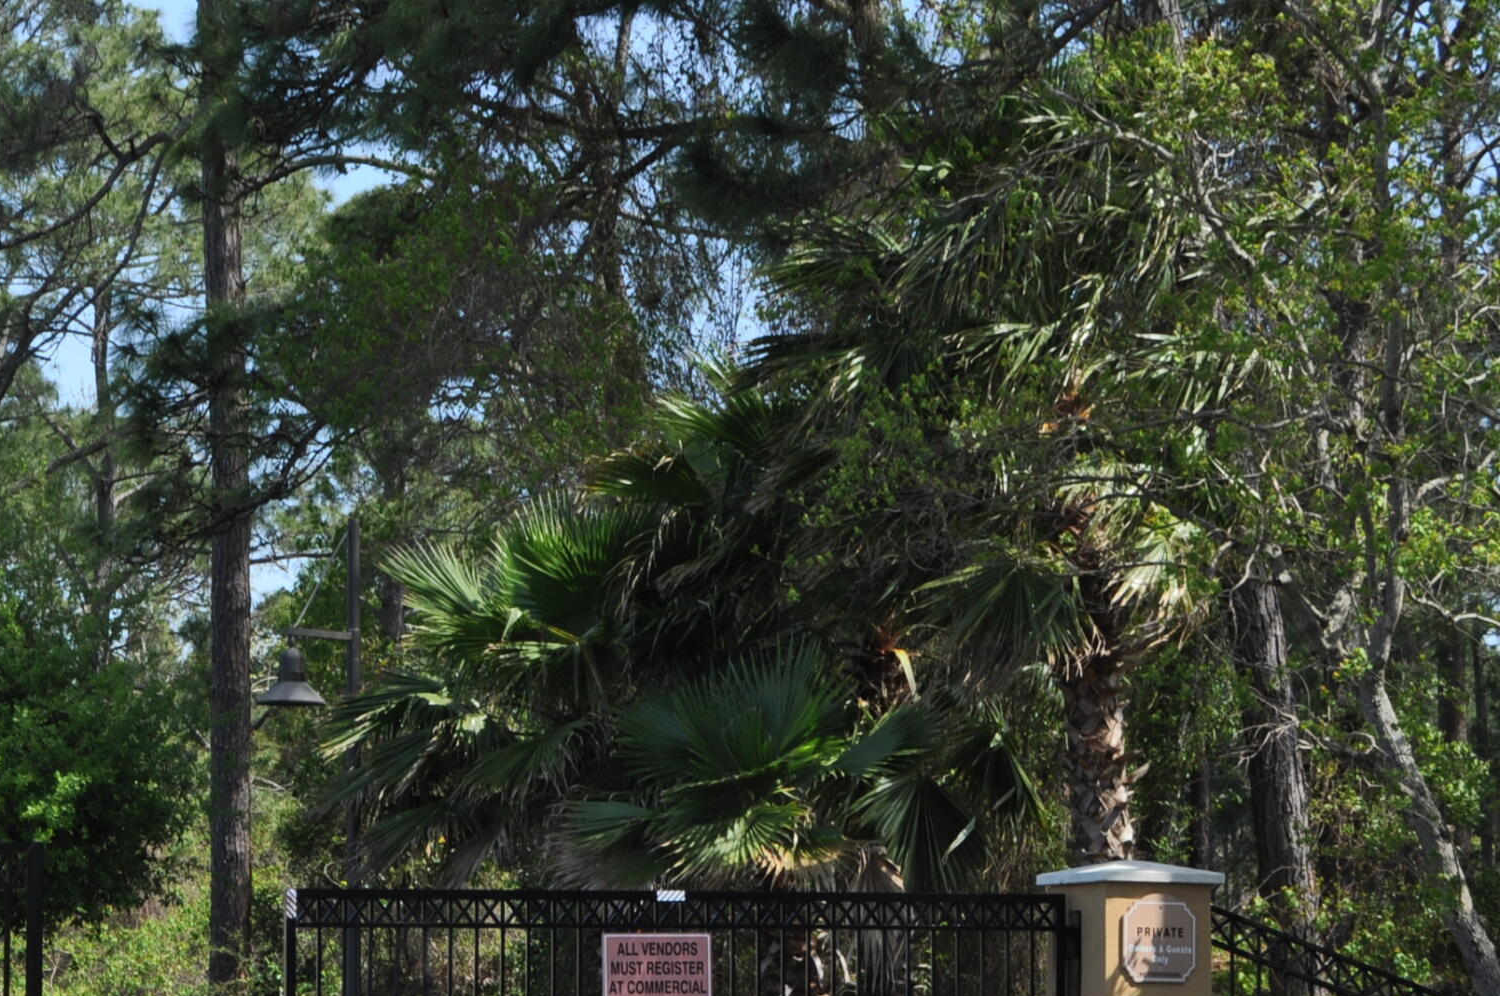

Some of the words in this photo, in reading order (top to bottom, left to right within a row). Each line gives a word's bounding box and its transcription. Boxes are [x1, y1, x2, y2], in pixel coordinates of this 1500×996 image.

[1136, 926, 1185, 938] PRIVATE
[617, 942, 639, 956] ALL
[641, 942, 698, 956] VENDORS
[610, 961, 643, 975] MUST
[646, 961, 704, 975] REGISTER
[609, 980, 625, 994] AT
[627, 980, 706, 994] COMMERCIAL
